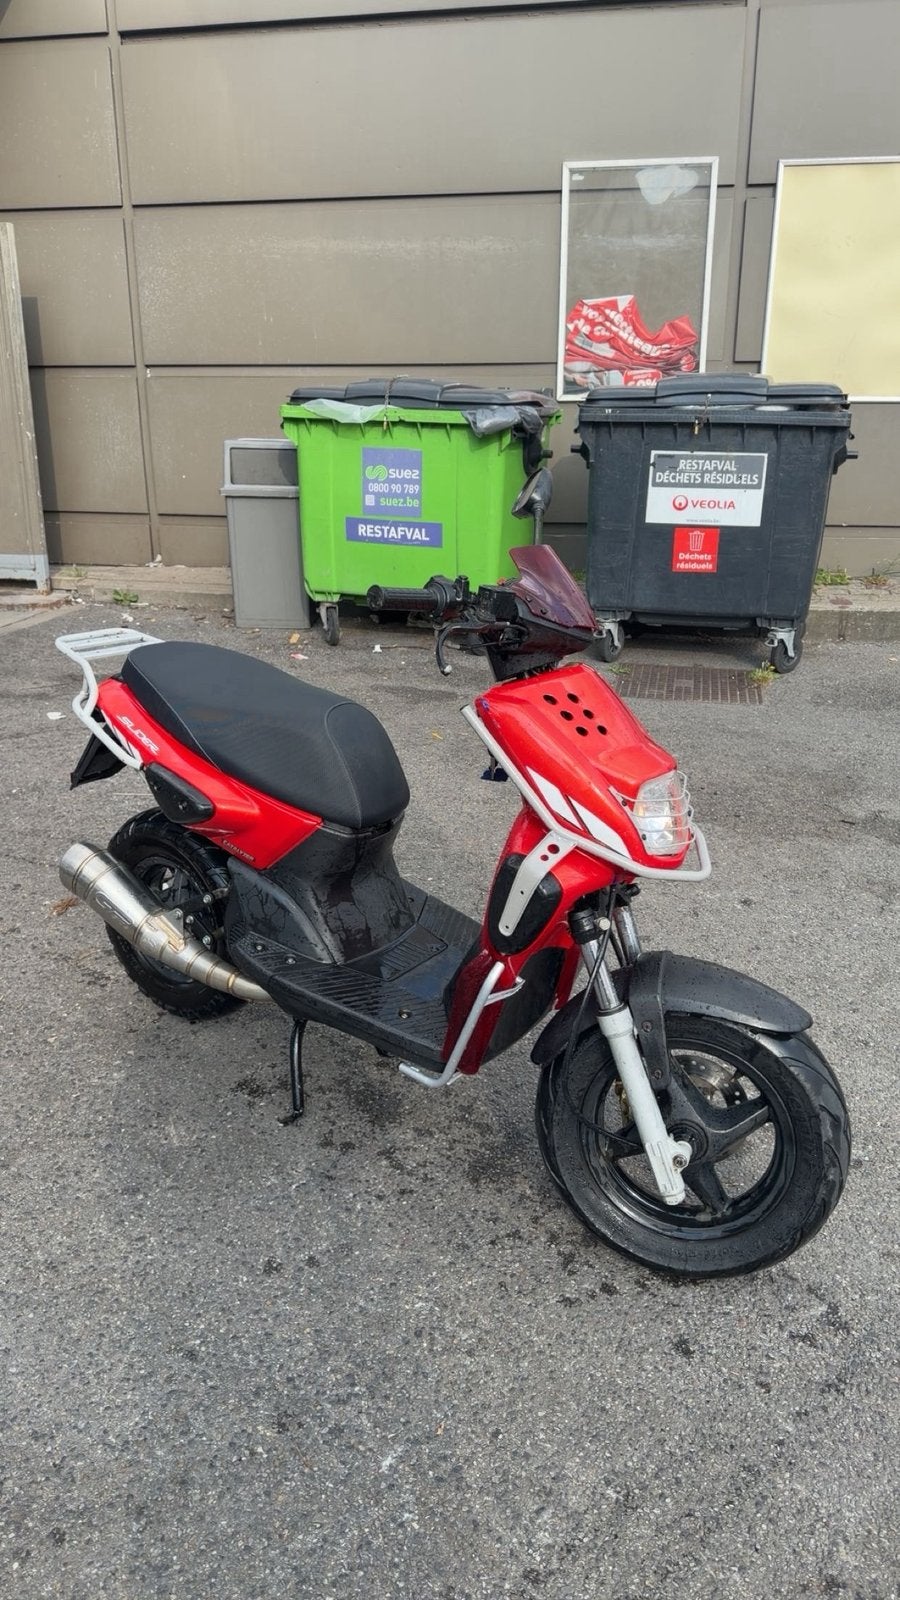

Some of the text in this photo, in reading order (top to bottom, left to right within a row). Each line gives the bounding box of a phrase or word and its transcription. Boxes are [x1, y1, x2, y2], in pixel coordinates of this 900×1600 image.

[680, 460, 736, 471] RESTAFVAL
[389, 468, 420, 480] suez
[656, 471, 759, 484] DÉCHETS RÉSIDUELS
[368, 483, 419, 494] 0800 90 789
[380, 496, 419, 507] suez.be
[691, 500, 736, 510] VEOLIA
[358, 524, 430, 540] RESTAFVAL
[678, 552, 712, 560] Déchets
[676, 562, 712, 570] résiduels
[116, 715, 160, 755] SLIDER
